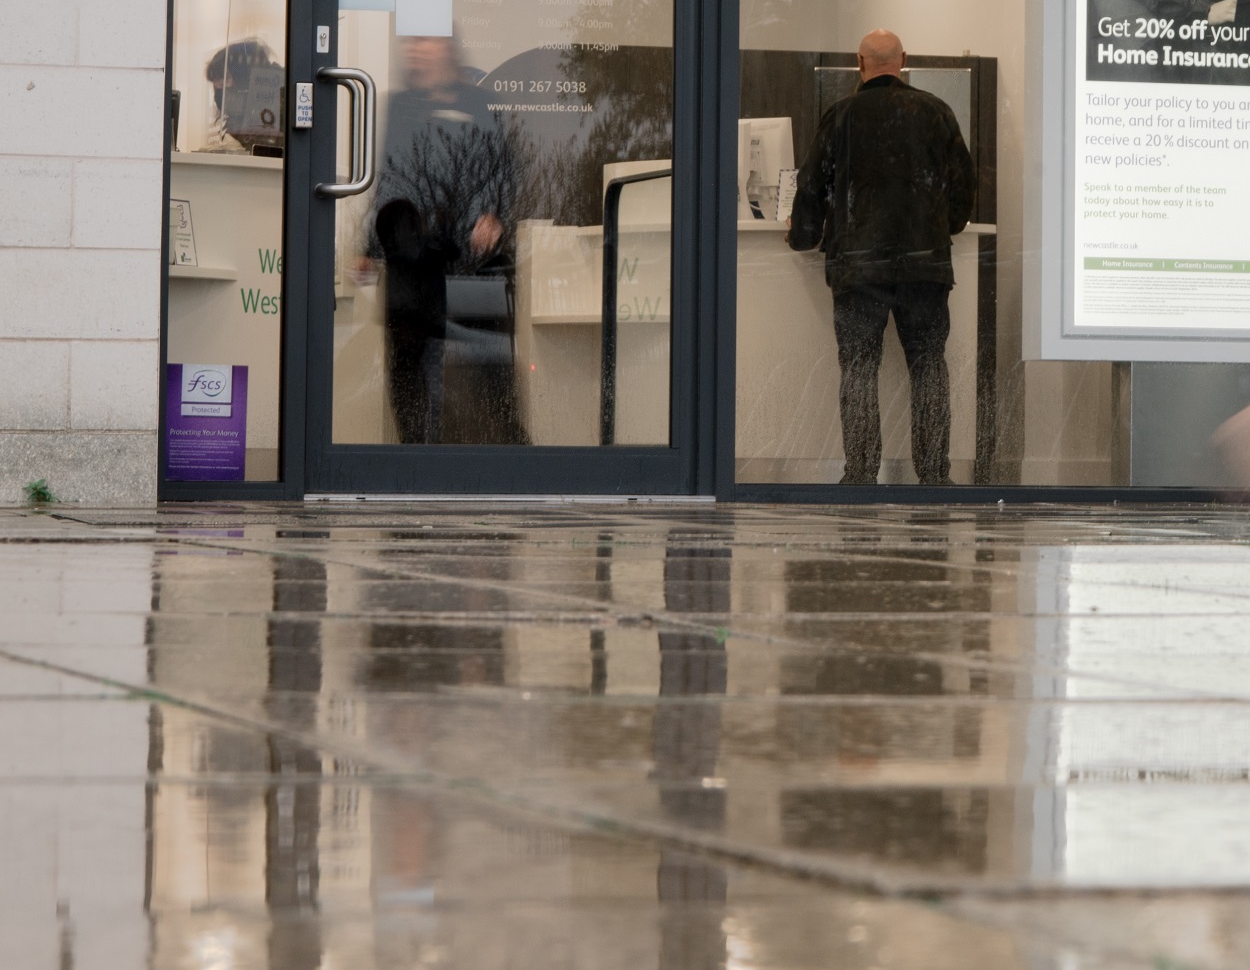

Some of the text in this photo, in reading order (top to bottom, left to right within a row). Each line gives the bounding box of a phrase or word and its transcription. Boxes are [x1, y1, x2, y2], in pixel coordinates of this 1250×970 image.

[462, 16, 491, 29] Friday
[1097, 16, 1250, 46] Get 20% off your
[462, 39, 503, 51] Saturday
[1097, 43, 1159, 65] Home
[494, 80, 587, 93] 0191 267 5038
[486, 102, 594, 113] www.newcastle.co.uk
[1086, 93, 1121, 107] Tailor
[1123, 96, 1152, 110] your
[1155, 96, 1192, 112] policy
[1196, 98, 1209, 110] to
[1212, 100, 1235, 113] you
[1085, 113, 1125, 128] home,
[1128, 114, 1154, 128] and
[1156, 115, 1174, 128] for
[1178, 119, 1186, 129] a
[1189, 116, 1232, 130] limited
[1085, 133, 1129, 146] receive
[1133, 137, 1141, 147] a
[1176, 135, 1230, 149] discount
[1233, 139, 1249, 150] on
[1085, 154, 1112, 165] new
[1084, 182, 1227, 195] Speak to a member of the team
[1084, 196, 1214, 209] today about how easy it is to
[1083, 209, 1170, 221] protect your home.
[1083, 240, 1139, 250] newcastle.co.uk
[1102, 259, 1153, 269] Home Insurance
[1174, 261, 1234, 271] Contents Insurance
[240, 288, 282, 315] Wes
[191, 405, 221, 415] Protected
[169, 428, 201, 438] Protecting
[217, 430, 239, 438] Money
